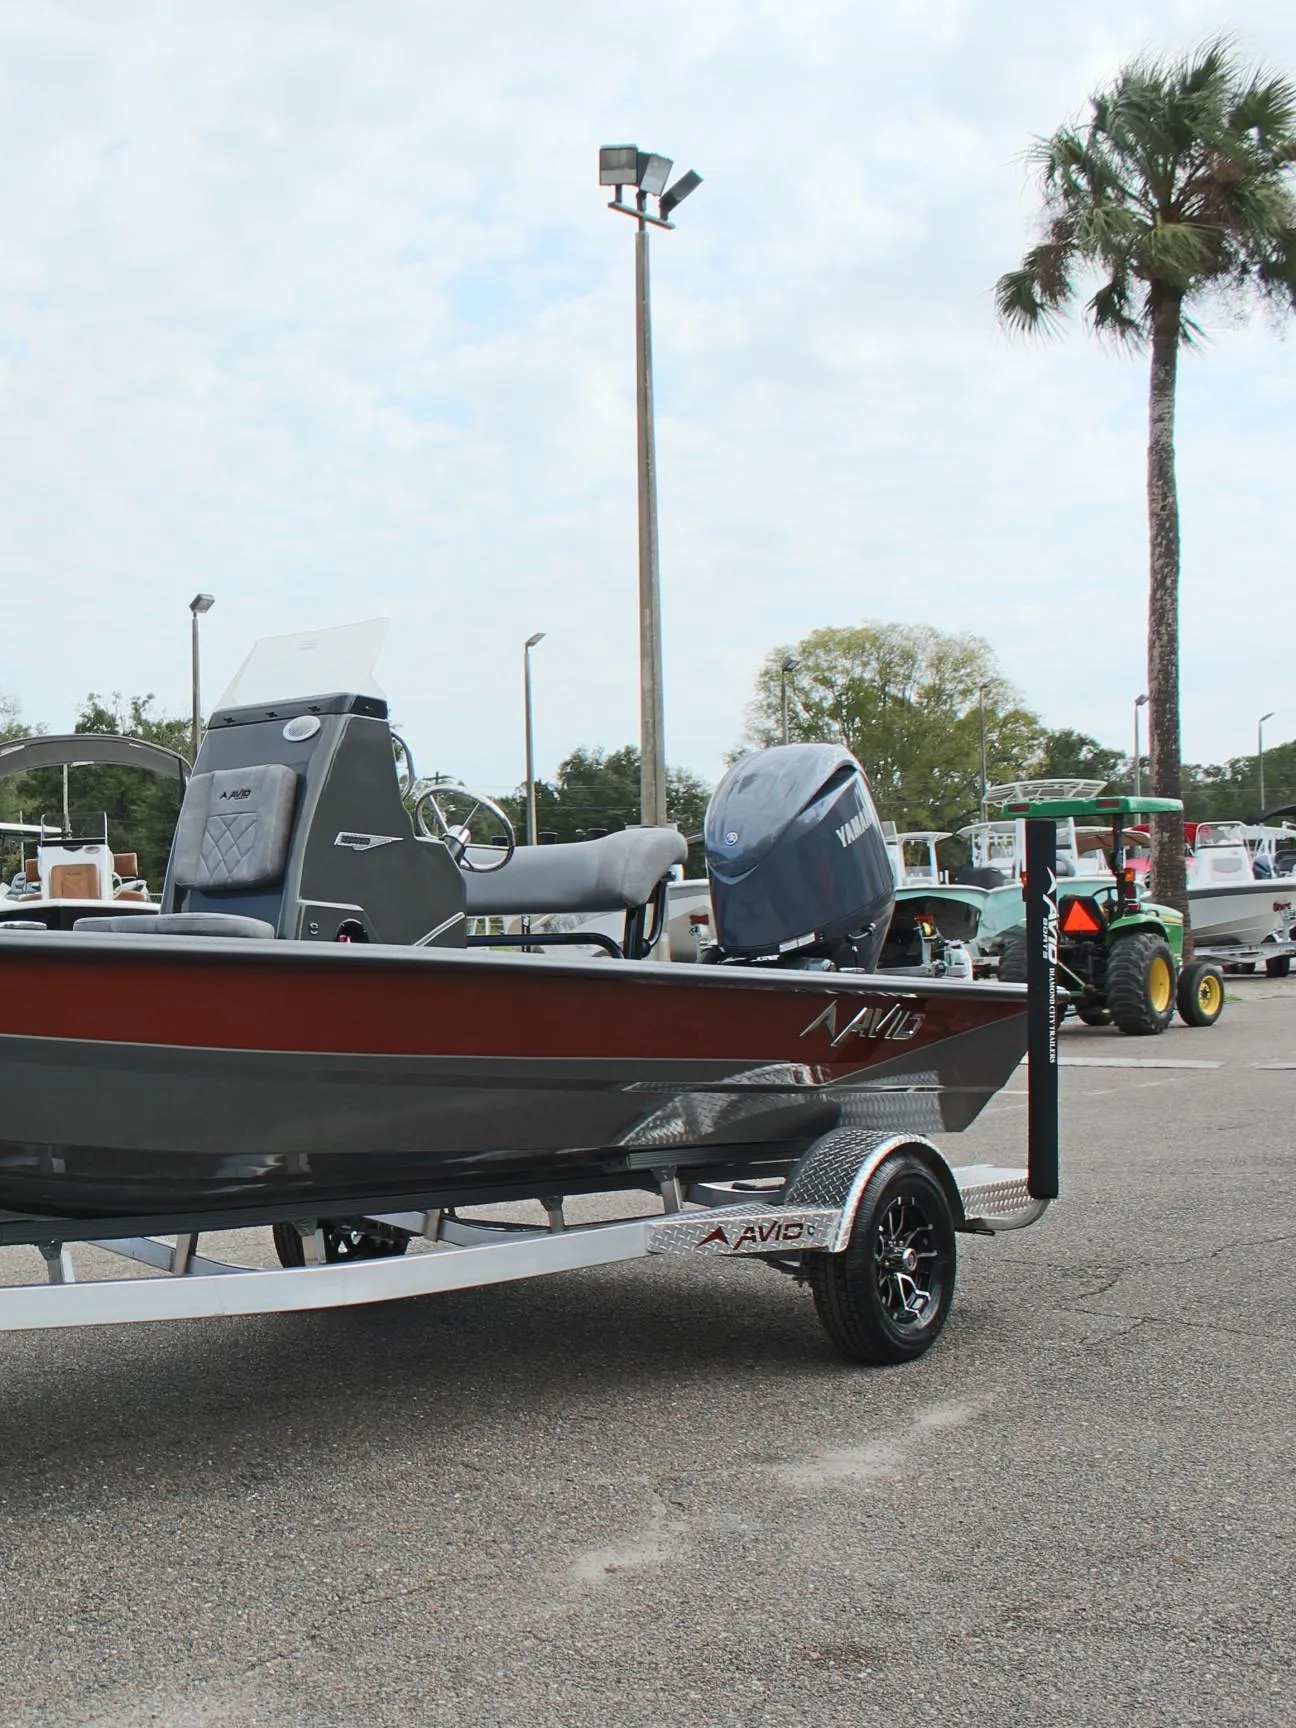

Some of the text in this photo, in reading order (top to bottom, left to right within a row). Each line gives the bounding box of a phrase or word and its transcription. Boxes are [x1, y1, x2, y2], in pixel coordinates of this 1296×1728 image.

[227, 788, 251, 800] AVID
[835, 806, 873, 848] YAMA
[1043, 894, 1059, 965] AVID
[732, 1220, 804, 1250] AVID
